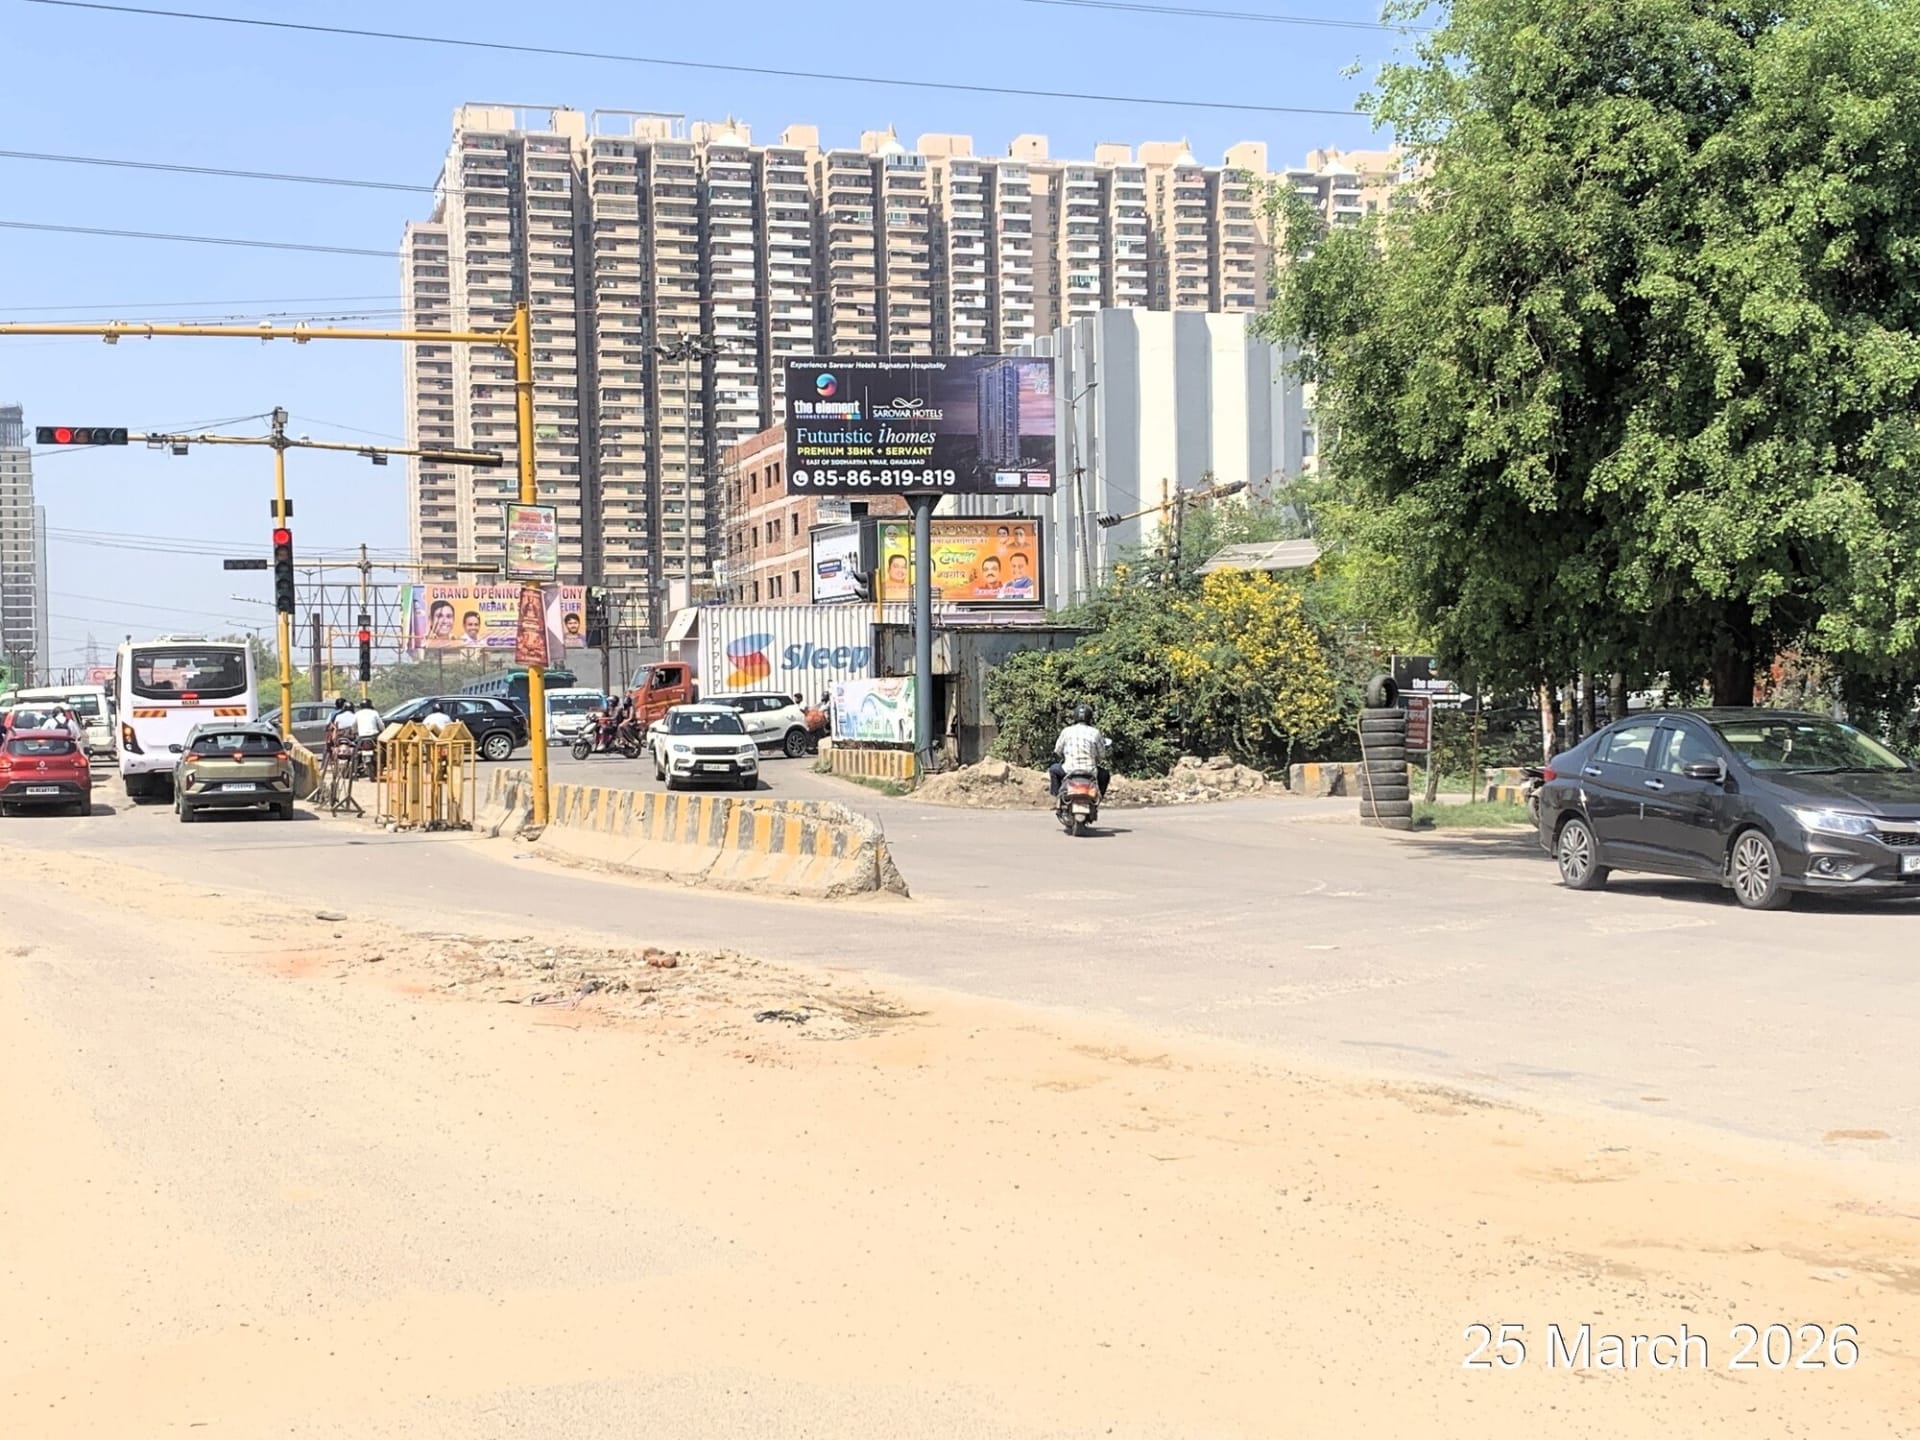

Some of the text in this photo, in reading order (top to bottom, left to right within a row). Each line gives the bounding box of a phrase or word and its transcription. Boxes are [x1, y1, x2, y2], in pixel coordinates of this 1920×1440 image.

[911, 362, 947, 370] Hospitality
[793, 400, 861, 414] the element
[872, 409, 943, 418] SAROVAR HOTELS
[796, 422, 936, 444] Futuristic ihomes
[797, 446, 844, 456] PREMIUM
[847, 446, 874, 456] 3BHK
[885, 446, 933, 456] SERVANT
[813, 469, 956, 486] 85-86-819-819
[432, 587, 470, 600] GRAND
[472, 587, 520, 600] OPENING
[1412, 678, 1426, 689] the
